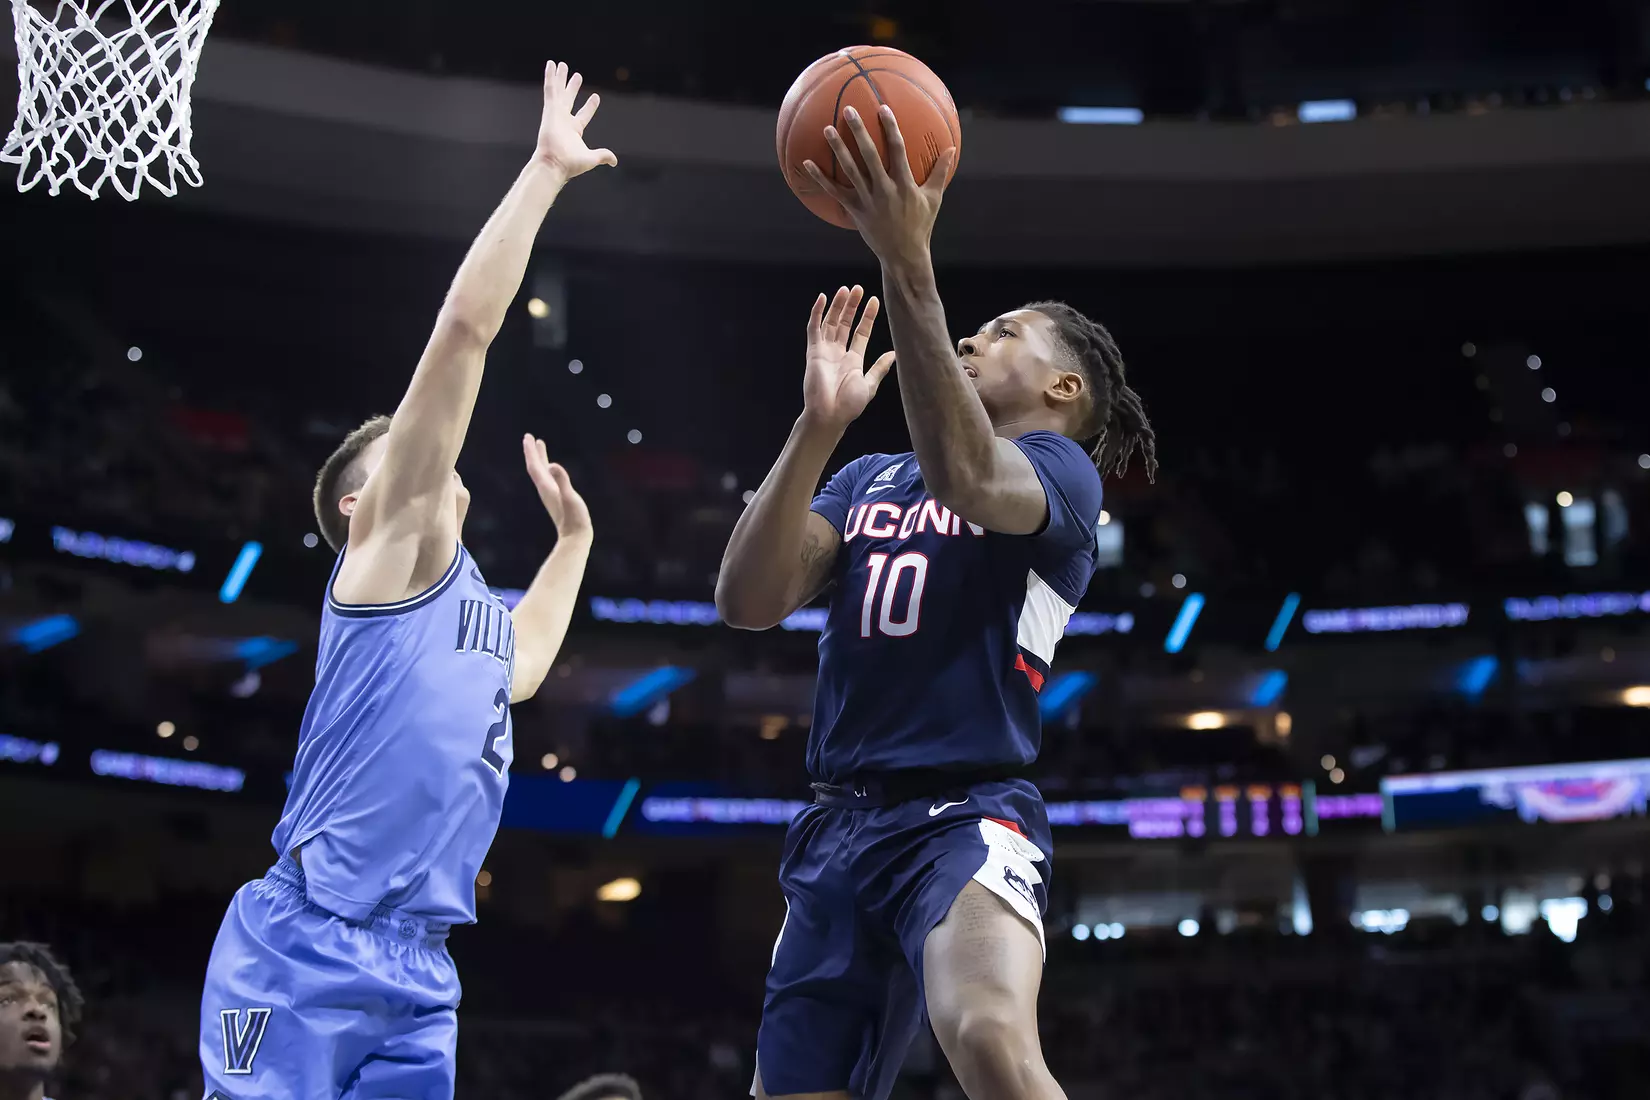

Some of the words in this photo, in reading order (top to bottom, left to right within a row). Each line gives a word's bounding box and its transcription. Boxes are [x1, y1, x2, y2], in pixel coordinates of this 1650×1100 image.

[860, 551, 929, 639] 10
[481, 687, 511, 778] 2
[219, 1007, 272, 1075] V
